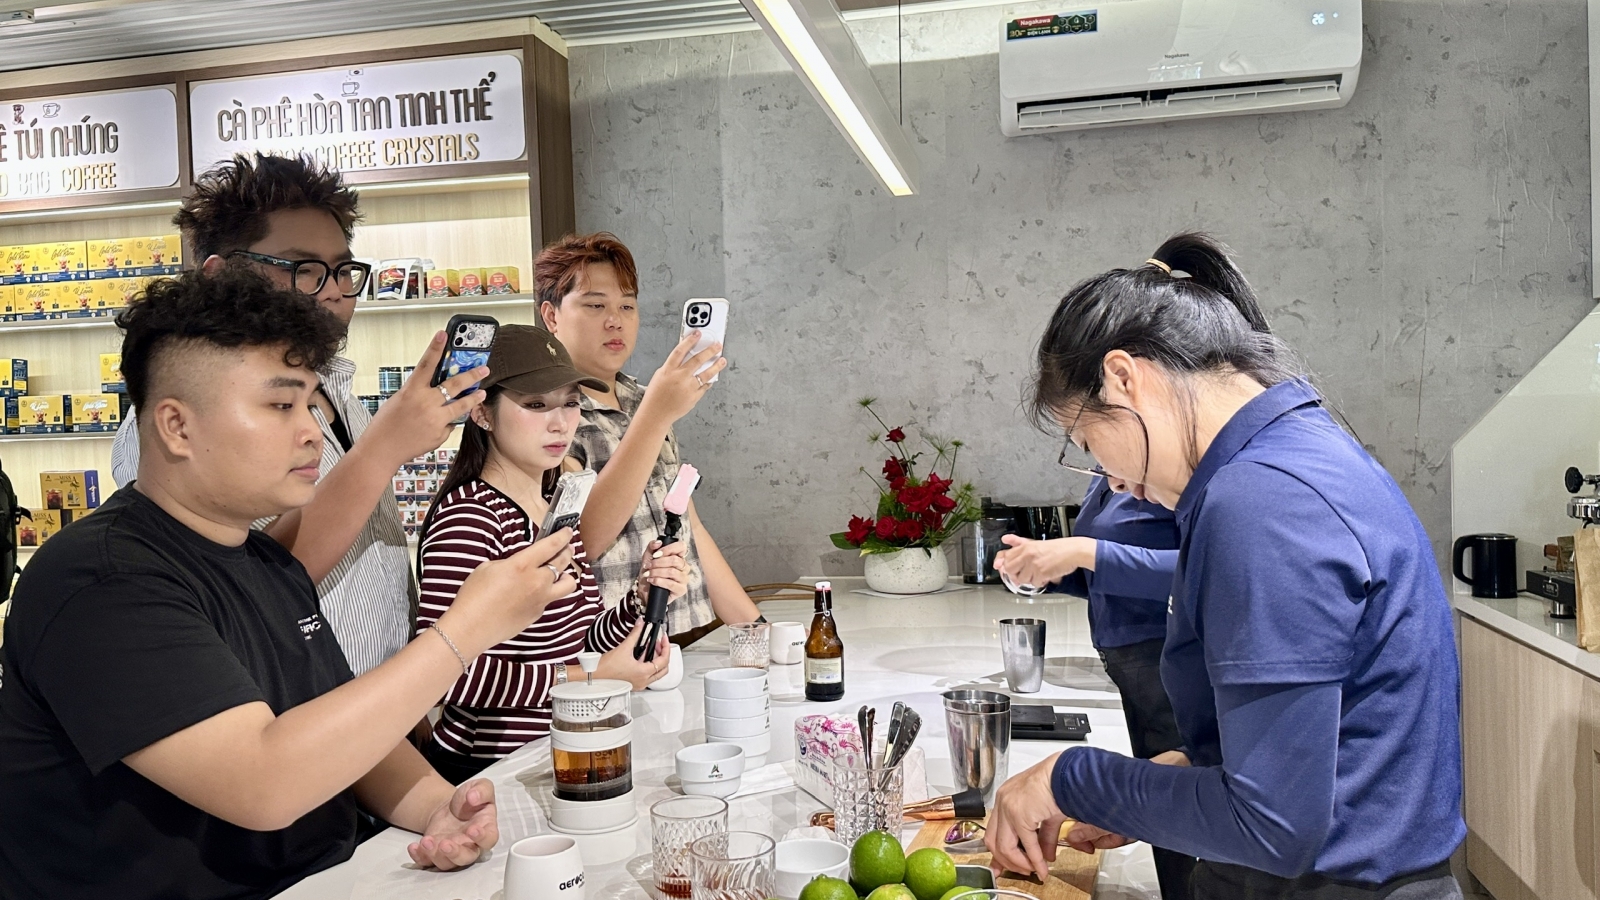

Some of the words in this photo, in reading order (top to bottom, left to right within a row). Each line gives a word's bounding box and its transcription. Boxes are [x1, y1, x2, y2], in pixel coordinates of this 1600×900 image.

[1020, 18, 1051, 27] Nagakawa
[217, 99, 247, 142] CÀ
[251, 96, 293, 140] PHÊ
[296, 92, 343, 136] HÒA
[347, 96, 392, 132] TAN
[395, 90, 448, 127] TINH
[450, 71, 496, 123] THỂ
[14, 117, 44, 160] TÚI
[50, 115, 119, 158] NHÚNG
[315, 140, 377, 169] COFFEE
[381, 132, 480, 166] CRYSTALS
[62, 162, 117, 192] COFFEE
